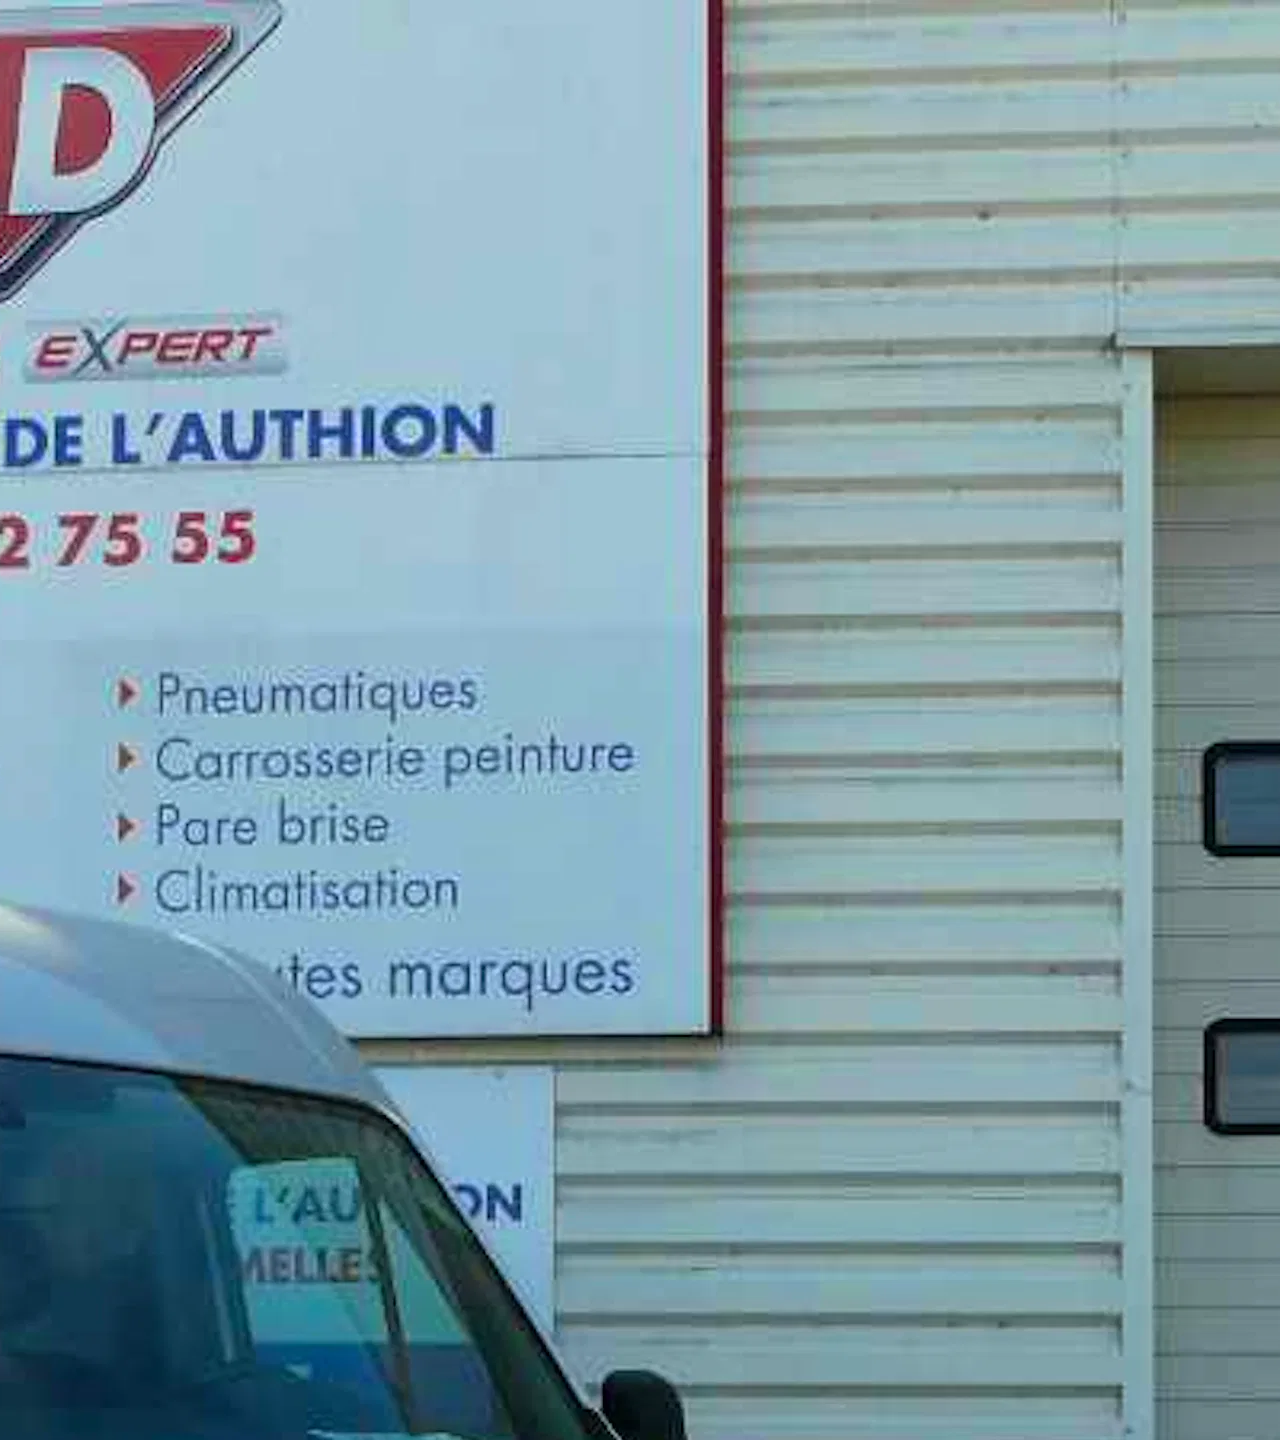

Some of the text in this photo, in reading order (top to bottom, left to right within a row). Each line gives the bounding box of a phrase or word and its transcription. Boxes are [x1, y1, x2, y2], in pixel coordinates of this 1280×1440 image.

[3, 415, 83, 468] DE
[111, 403, 495, 466] L'AUTHION
[57, 513, 141, 566] 75
[172, 510, 257, 564] 55
[157, 669, 479, 724] Pneumatiques
[156, 732, 635, 788] Carrosserie peinture
[156, 797, 390, 846] Pare brise
[155, 866, 460, 913] Climatisation
[389, 954, 635, 1012] marques
